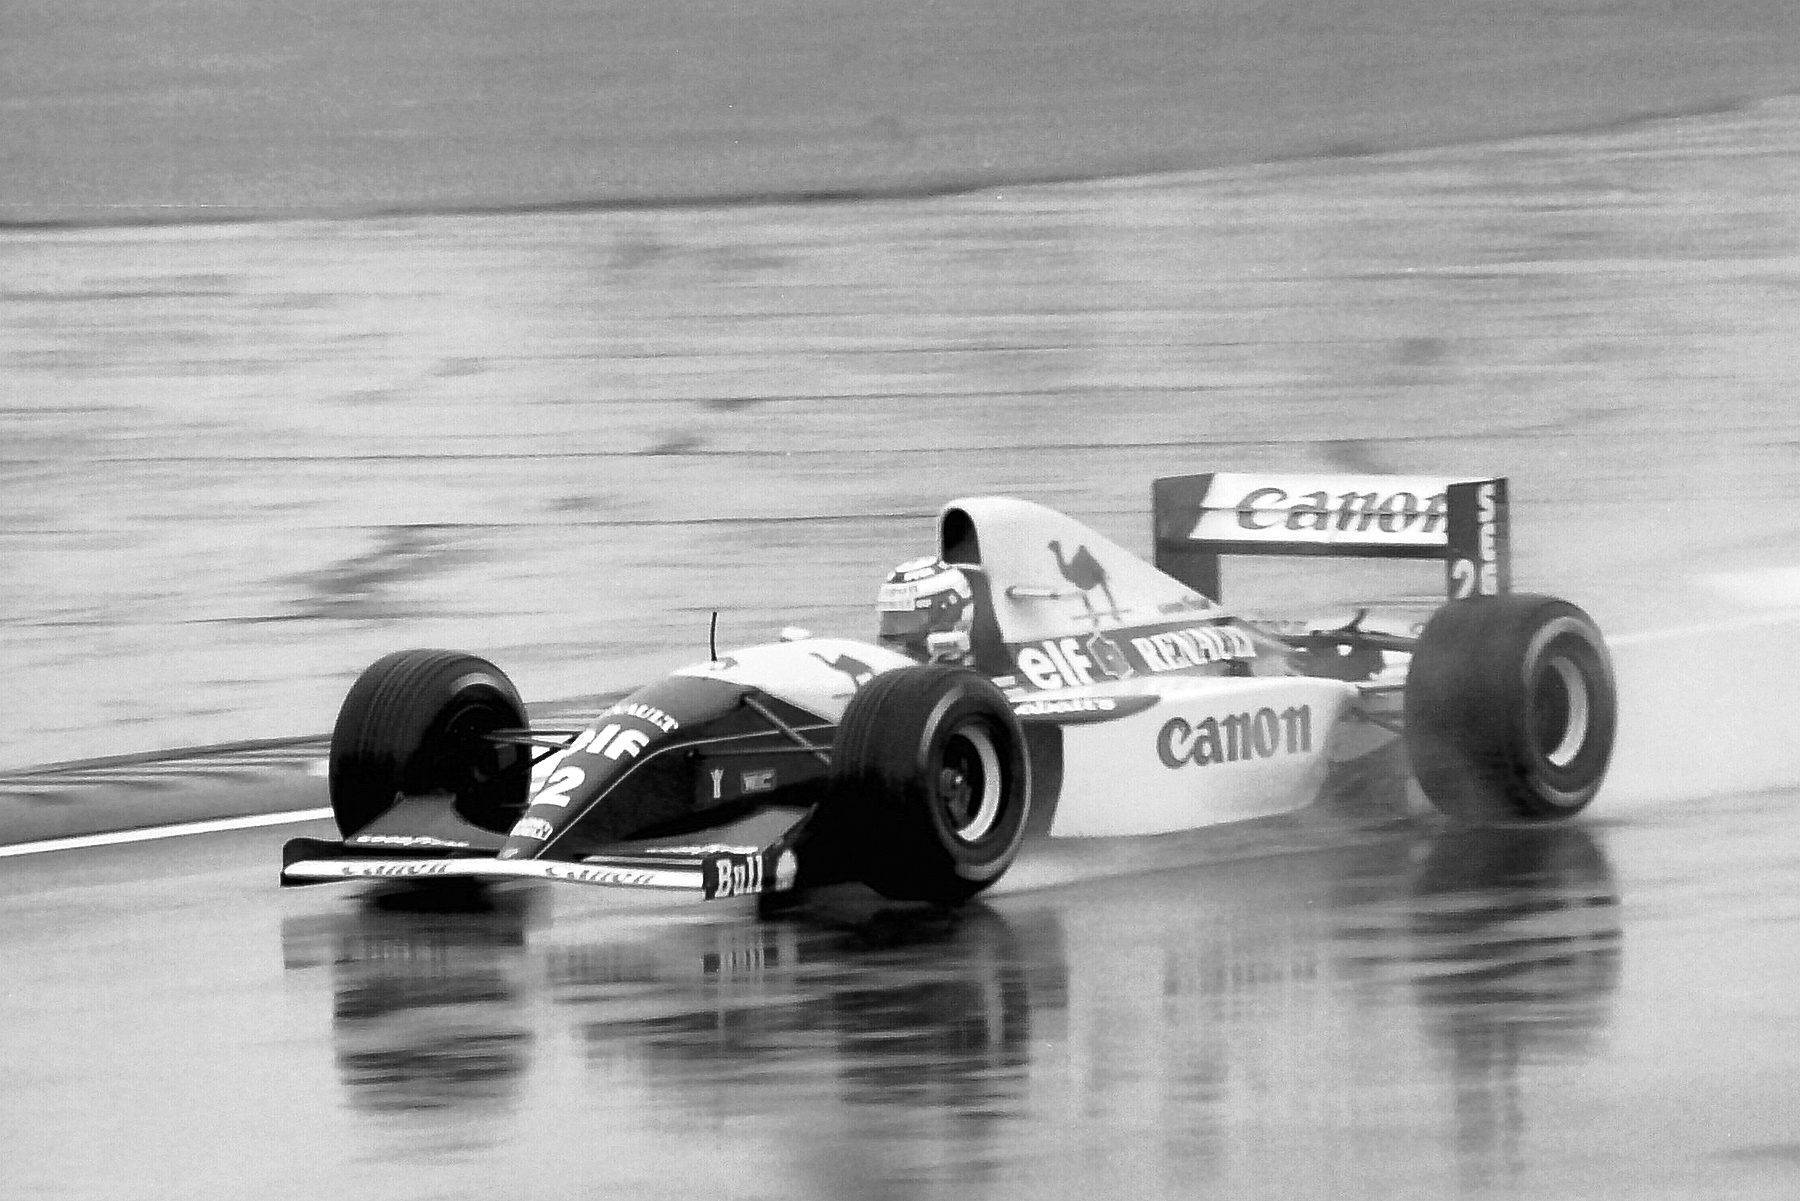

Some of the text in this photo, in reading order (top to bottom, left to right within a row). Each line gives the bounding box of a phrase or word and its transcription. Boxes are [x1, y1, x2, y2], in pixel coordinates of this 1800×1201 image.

[1452, 559, 1475, 600] 2
[1017, 637, 1093, 690] elf
[1155, 704, 1312, 770] Canon
[530, 765, 586, 808] 2
